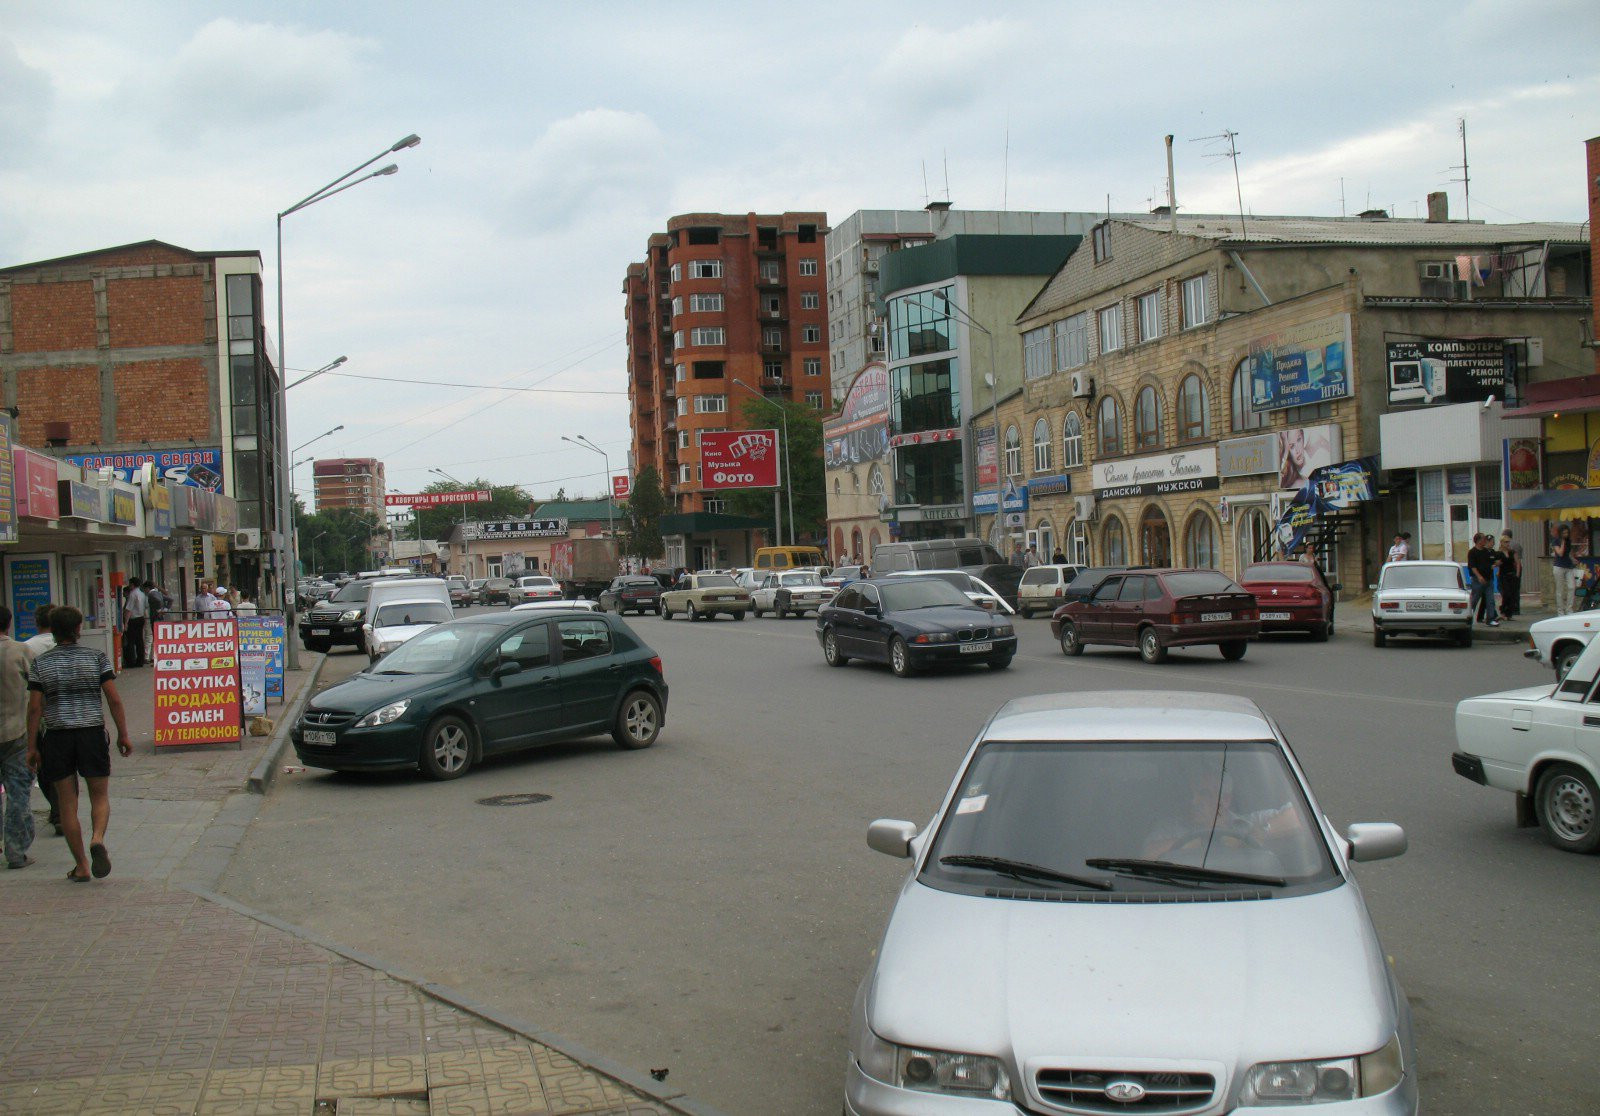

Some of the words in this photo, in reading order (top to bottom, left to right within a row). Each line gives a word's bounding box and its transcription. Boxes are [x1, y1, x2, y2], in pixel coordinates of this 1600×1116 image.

[1427, 342, 1503, 352] КОМПЬЮТЕРЫ
[1276, 358, 1302, 371] Продажа
[1278, 371, 1299, 382] Ремонт
[1280, 382, 1311, 395] Настройка
[1320, 382, 1346, 399] ИГРЫ
[84, 454, 155, 470] САЛОНОВ
[162, 452, 213, 465] СВЯЗИ
[707, 461, 741, 470] Музыка
[1103, 464, 1128, 483] Салон
[1102, 485, 1142, 499] ДАМСКИЙ
[1157, 479, 1203, 493] МУЖСКОЙ
[395, 495, 429, 504] КВАРТИРЫ
[923, 509, 961, 519] АПТЕКА
[487, 521, 556, 532] ZEBRA
[157, 621, 234, 640] ПРИЕМ
[239, 629, 272, 637] ПРИЕМ
[157, 640, 234, 654] ПЛАТЕЖЕЙ
[156, 674, 236, 691] ПОКУПКА
[157, 691, 236, 708] ПРОДАЖА
[167, 708, 224, 725] ОБМЕН
[155, 728, 175, 742] Б/У
[177, 725, 239, 740] ТЕЛЕФОНОВ
